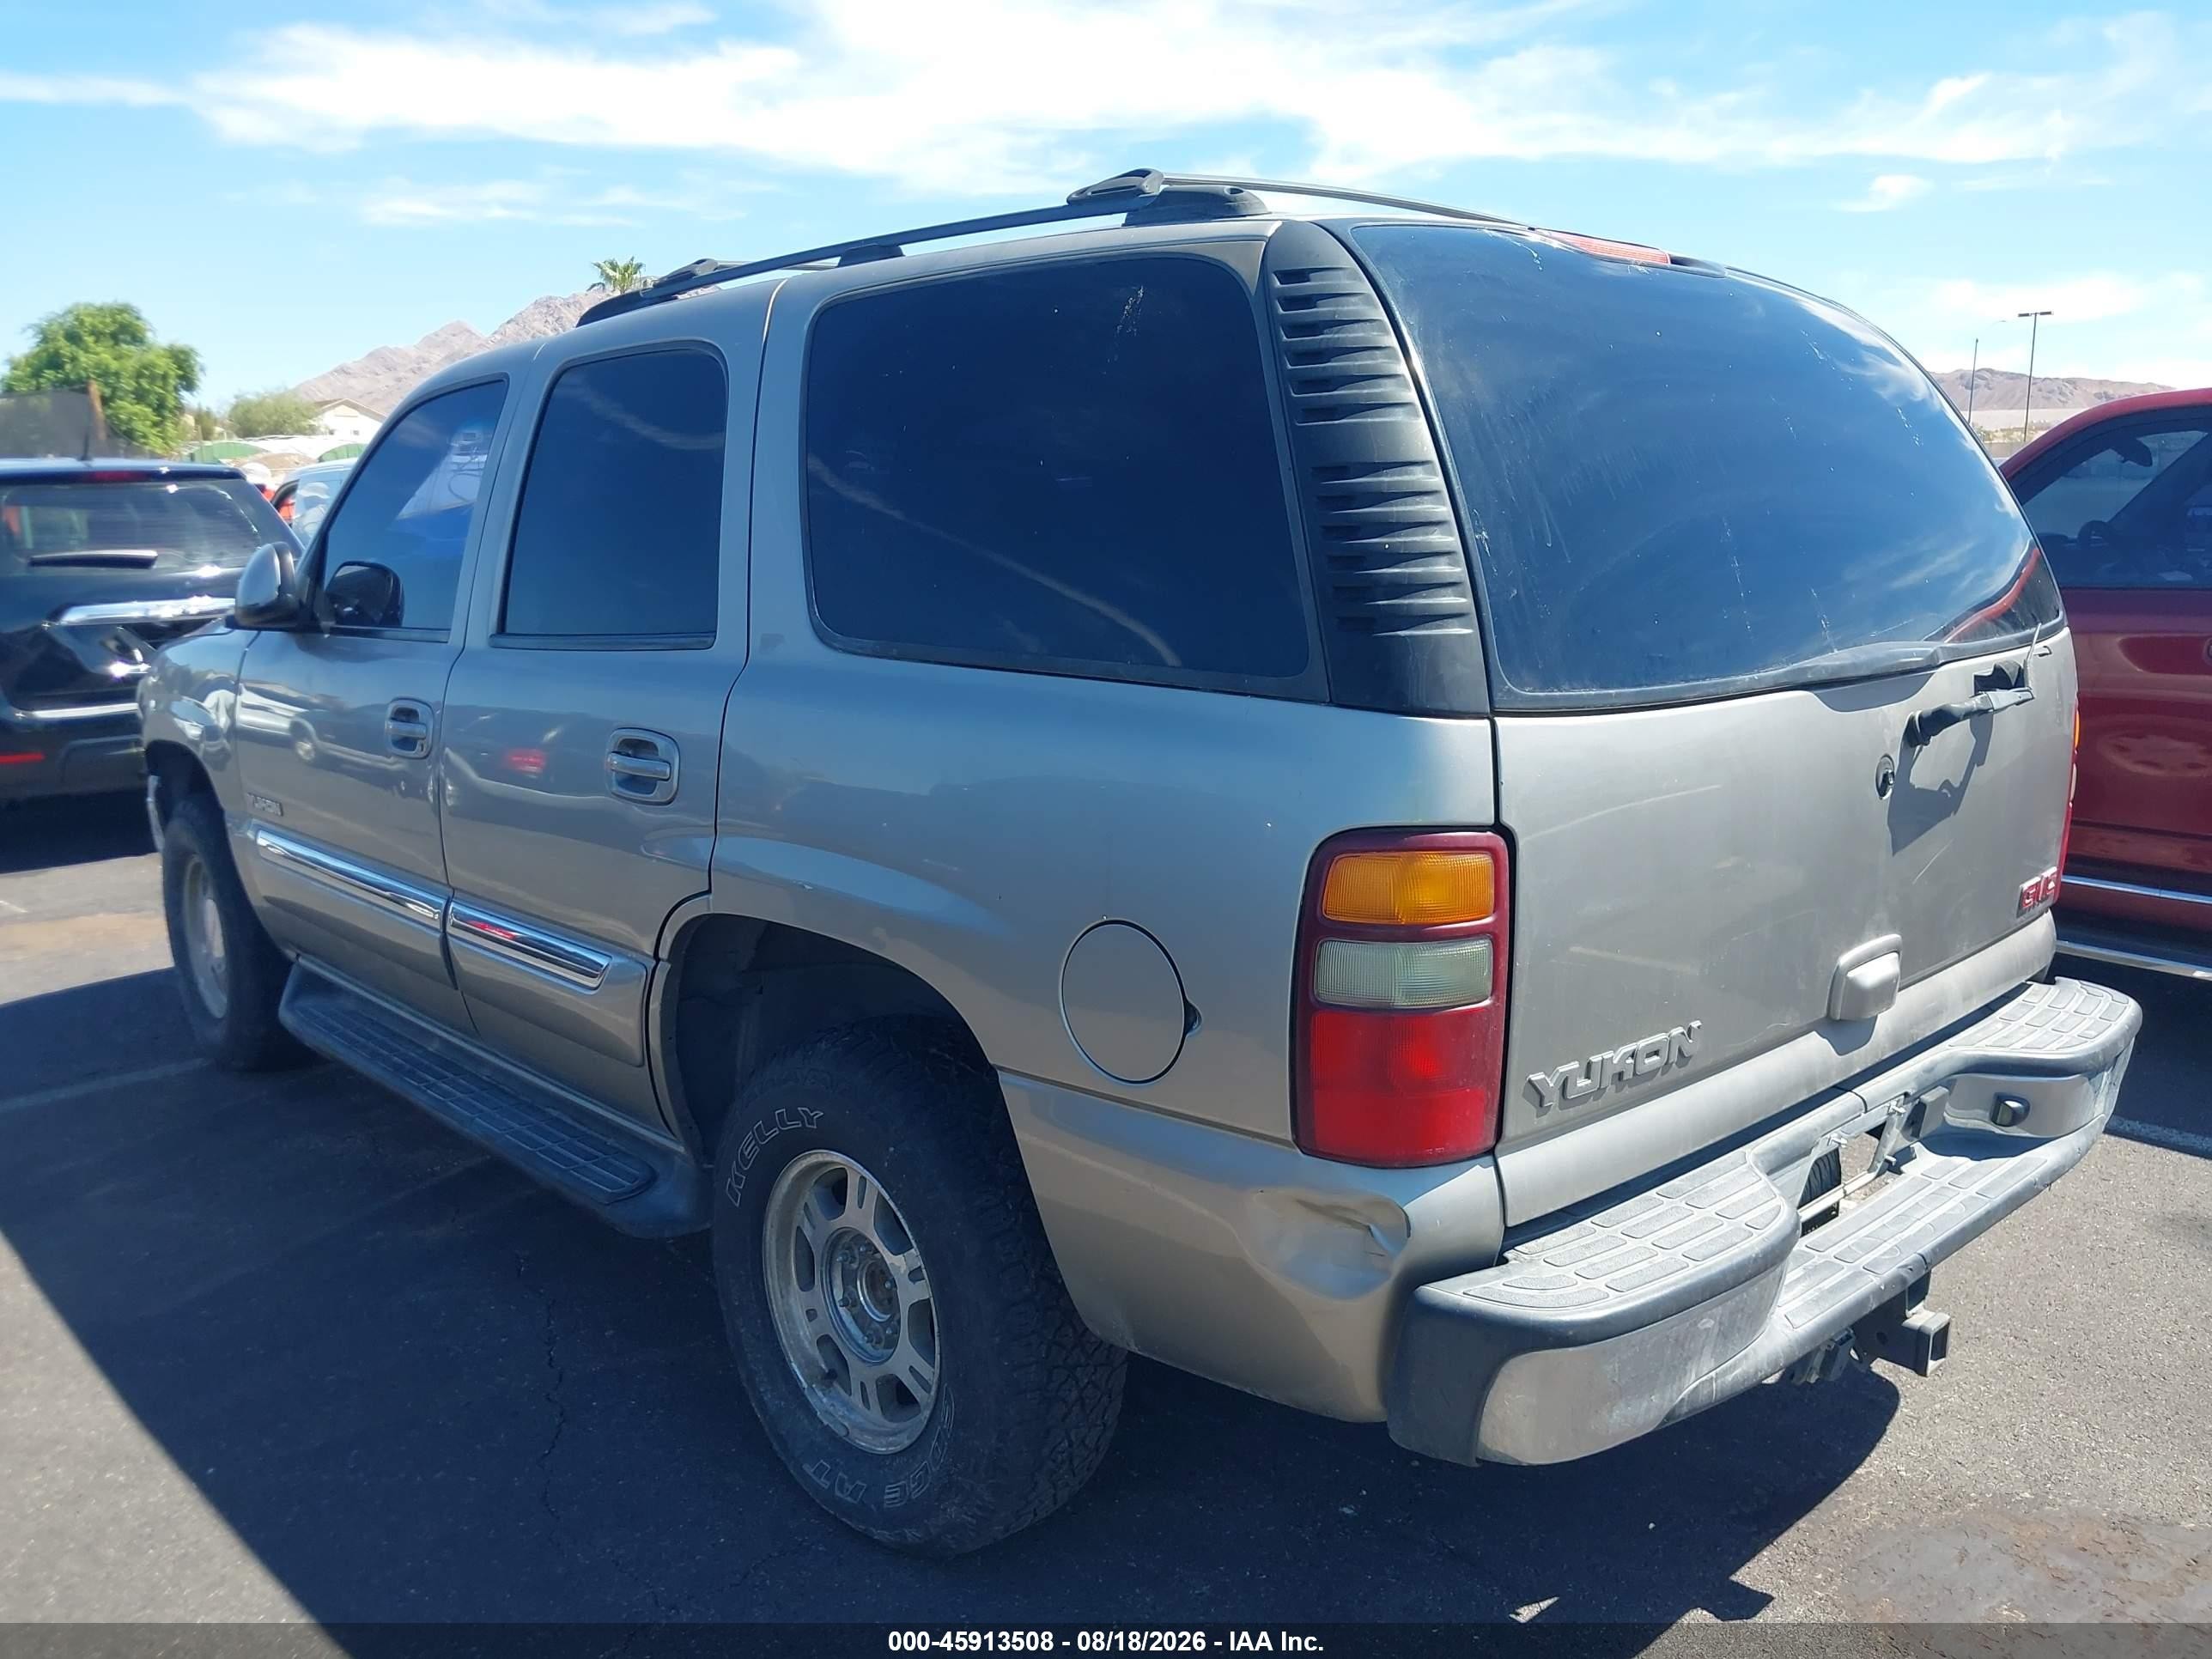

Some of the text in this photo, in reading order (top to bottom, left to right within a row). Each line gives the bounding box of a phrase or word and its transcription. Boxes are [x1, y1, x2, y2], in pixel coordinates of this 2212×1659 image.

[2020, 866, 2058, 908] GMC
[1527, 1020, 1702, 1108] YUKON
[726, 1107, 824, 1208] KELLY
[801, 1382, 956, 1509] EDGE AT
